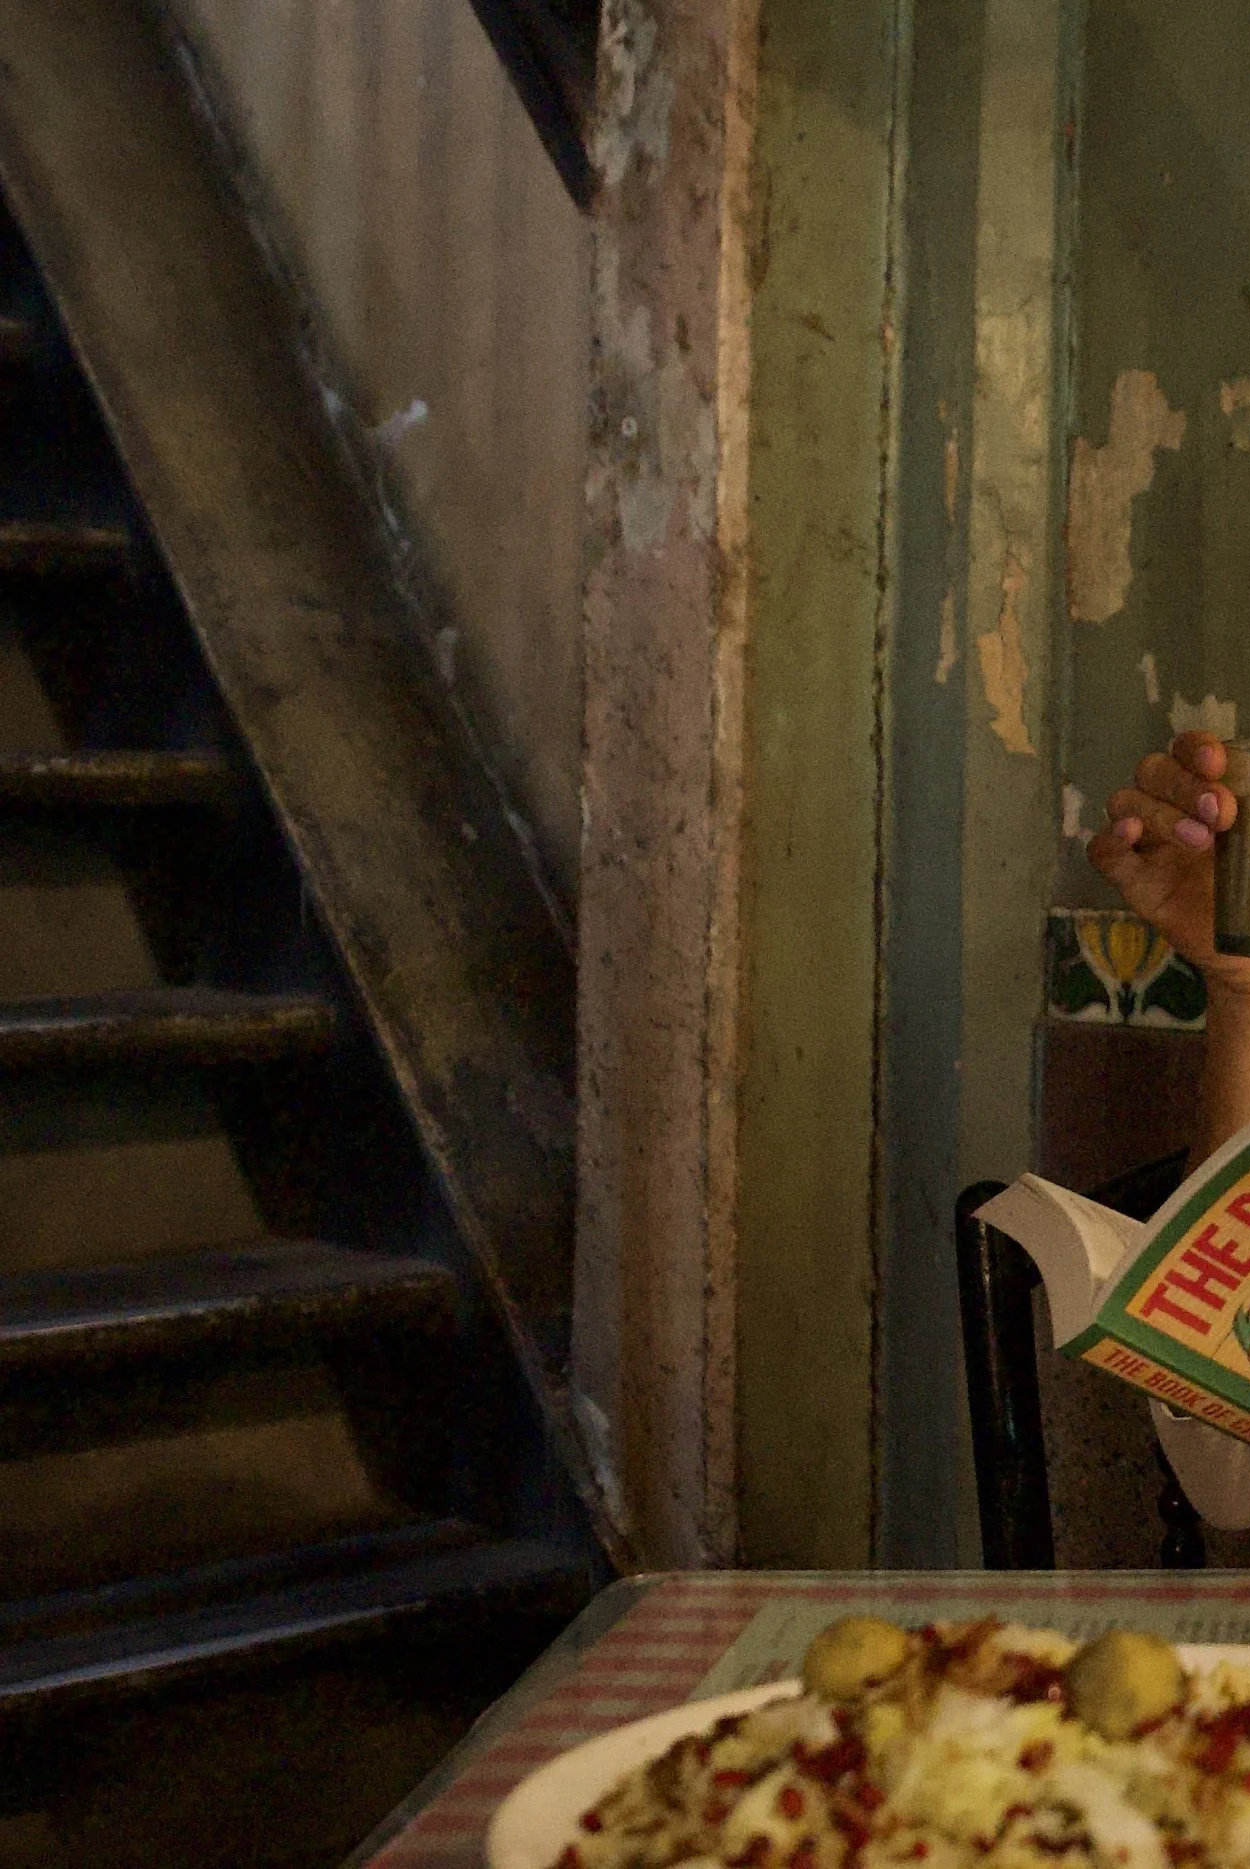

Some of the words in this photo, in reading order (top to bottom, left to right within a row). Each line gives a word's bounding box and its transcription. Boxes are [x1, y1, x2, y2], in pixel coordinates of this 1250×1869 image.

[1103, 1349, 1149, 1378] THE
[1144, 1369, 1206, 1408] BOOK
[1202, 1402, 1235, 1422] OF
